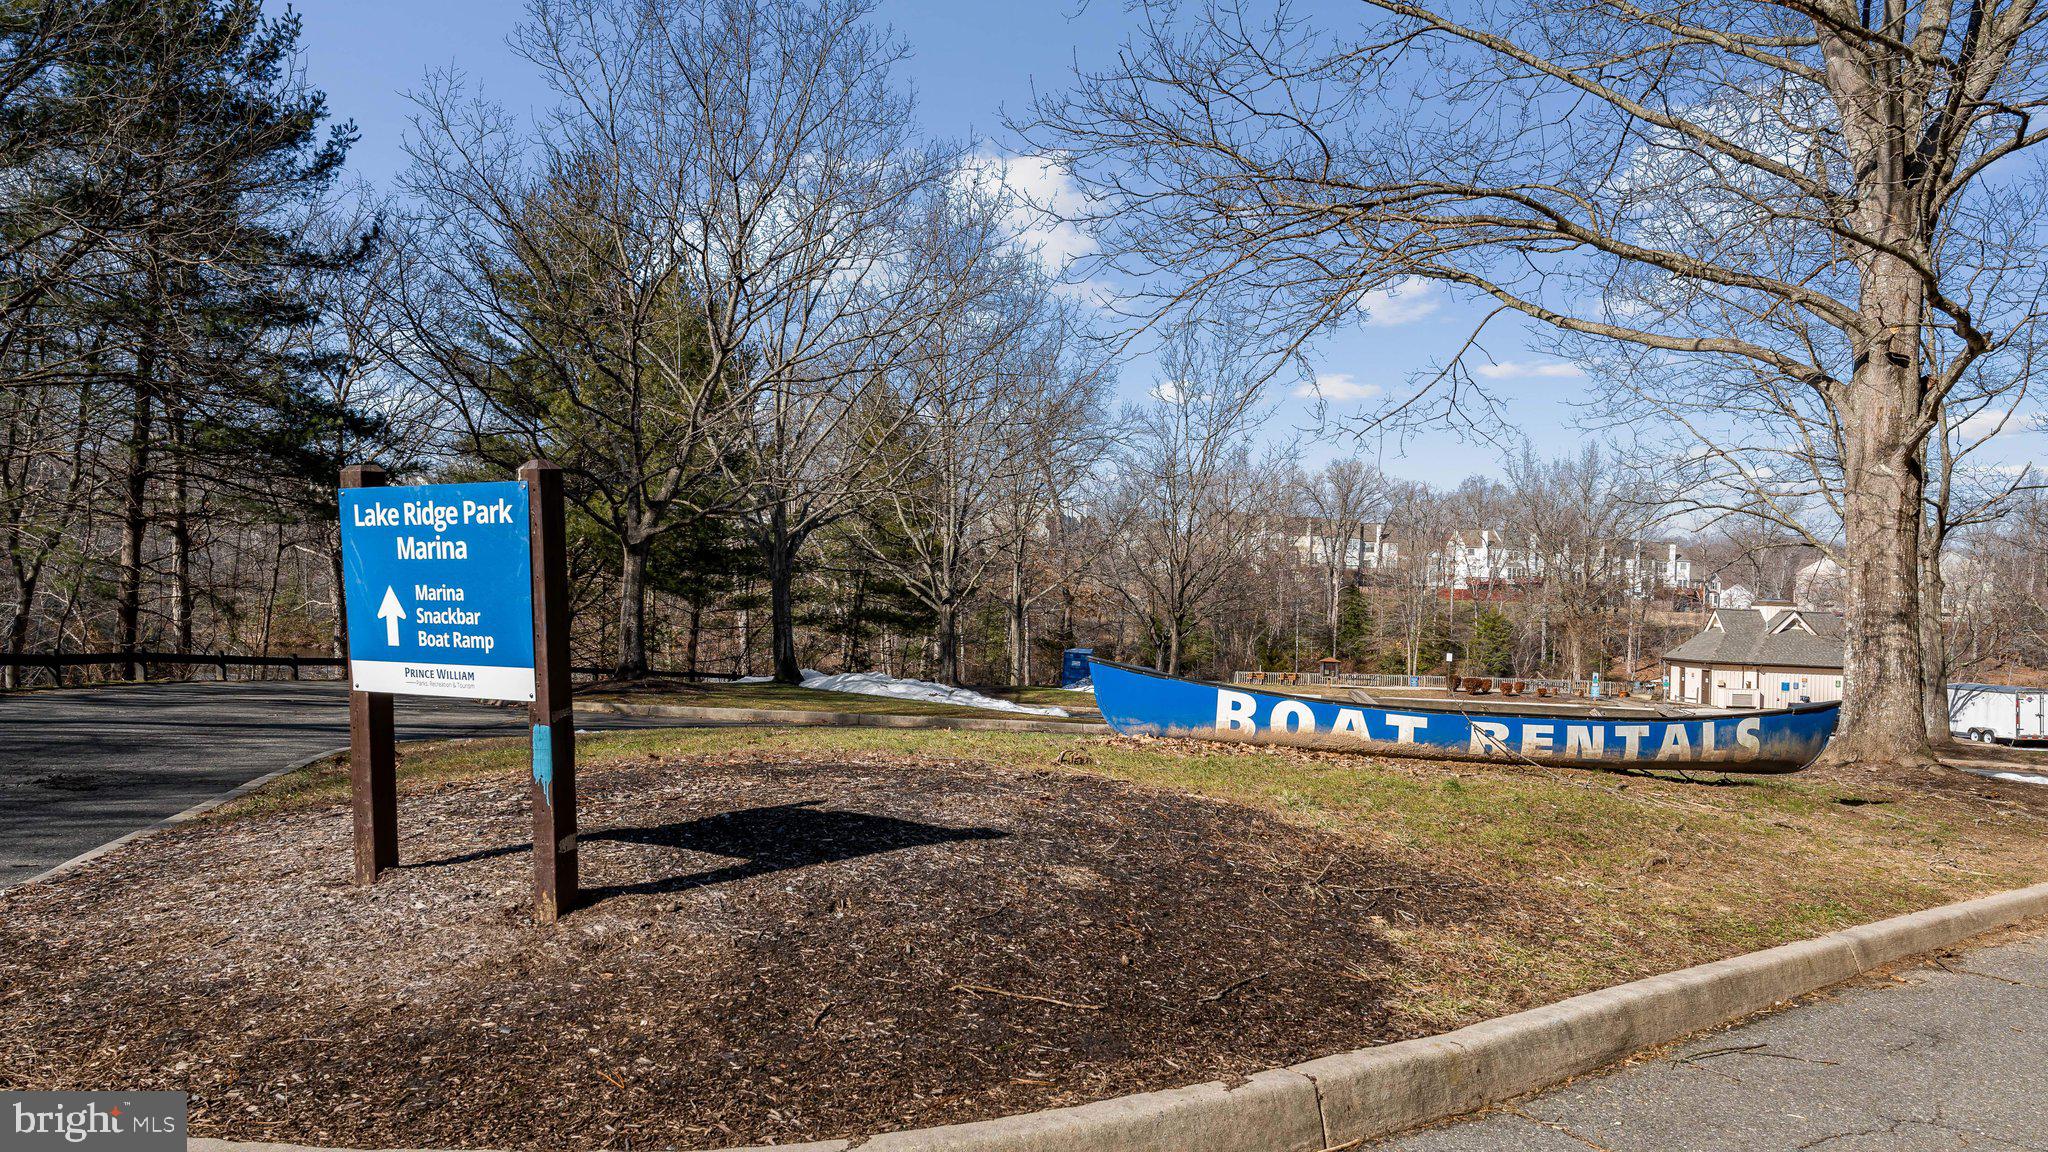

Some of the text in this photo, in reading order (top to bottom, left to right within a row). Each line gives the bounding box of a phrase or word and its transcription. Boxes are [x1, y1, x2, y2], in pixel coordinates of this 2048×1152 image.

[353, 498, 513, 532] Lake Ridge Park
[396, 535, 468, 560] Marina
[415, 584, 465, 602] Marina
[416, 607, 481, 625] Snackbar
[418, 630, 494, 653] Boat Ramp
[404, 667, 475, 681] PRINCE WILLIAM
[1215, 688, 1761, 763] BOAT RENTALS
